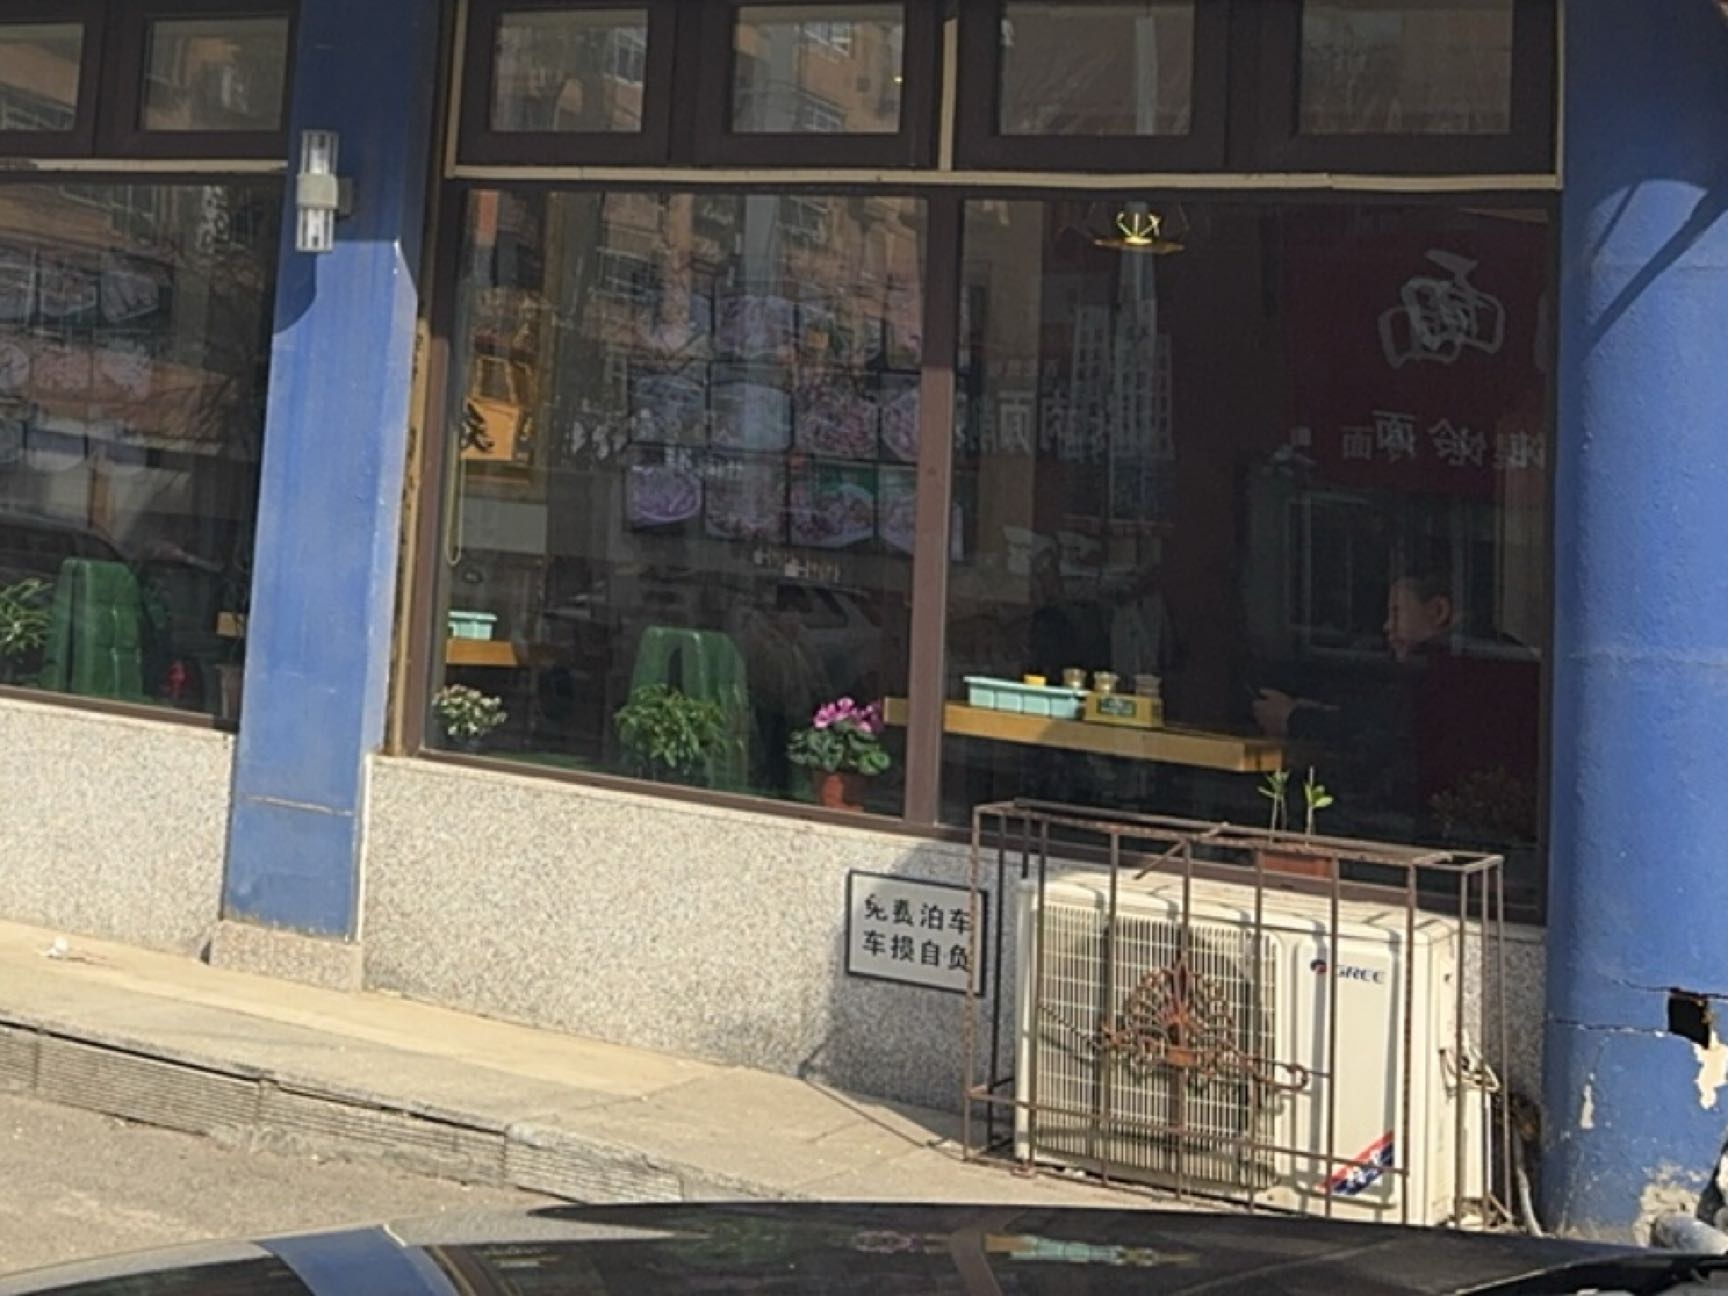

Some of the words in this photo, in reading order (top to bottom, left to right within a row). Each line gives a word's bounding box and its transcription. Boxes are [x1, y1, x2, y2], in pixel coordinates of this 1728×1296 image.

[863, 892, 974, 935] 免费泊车
[861, 929, 971, 972] 车损自负
